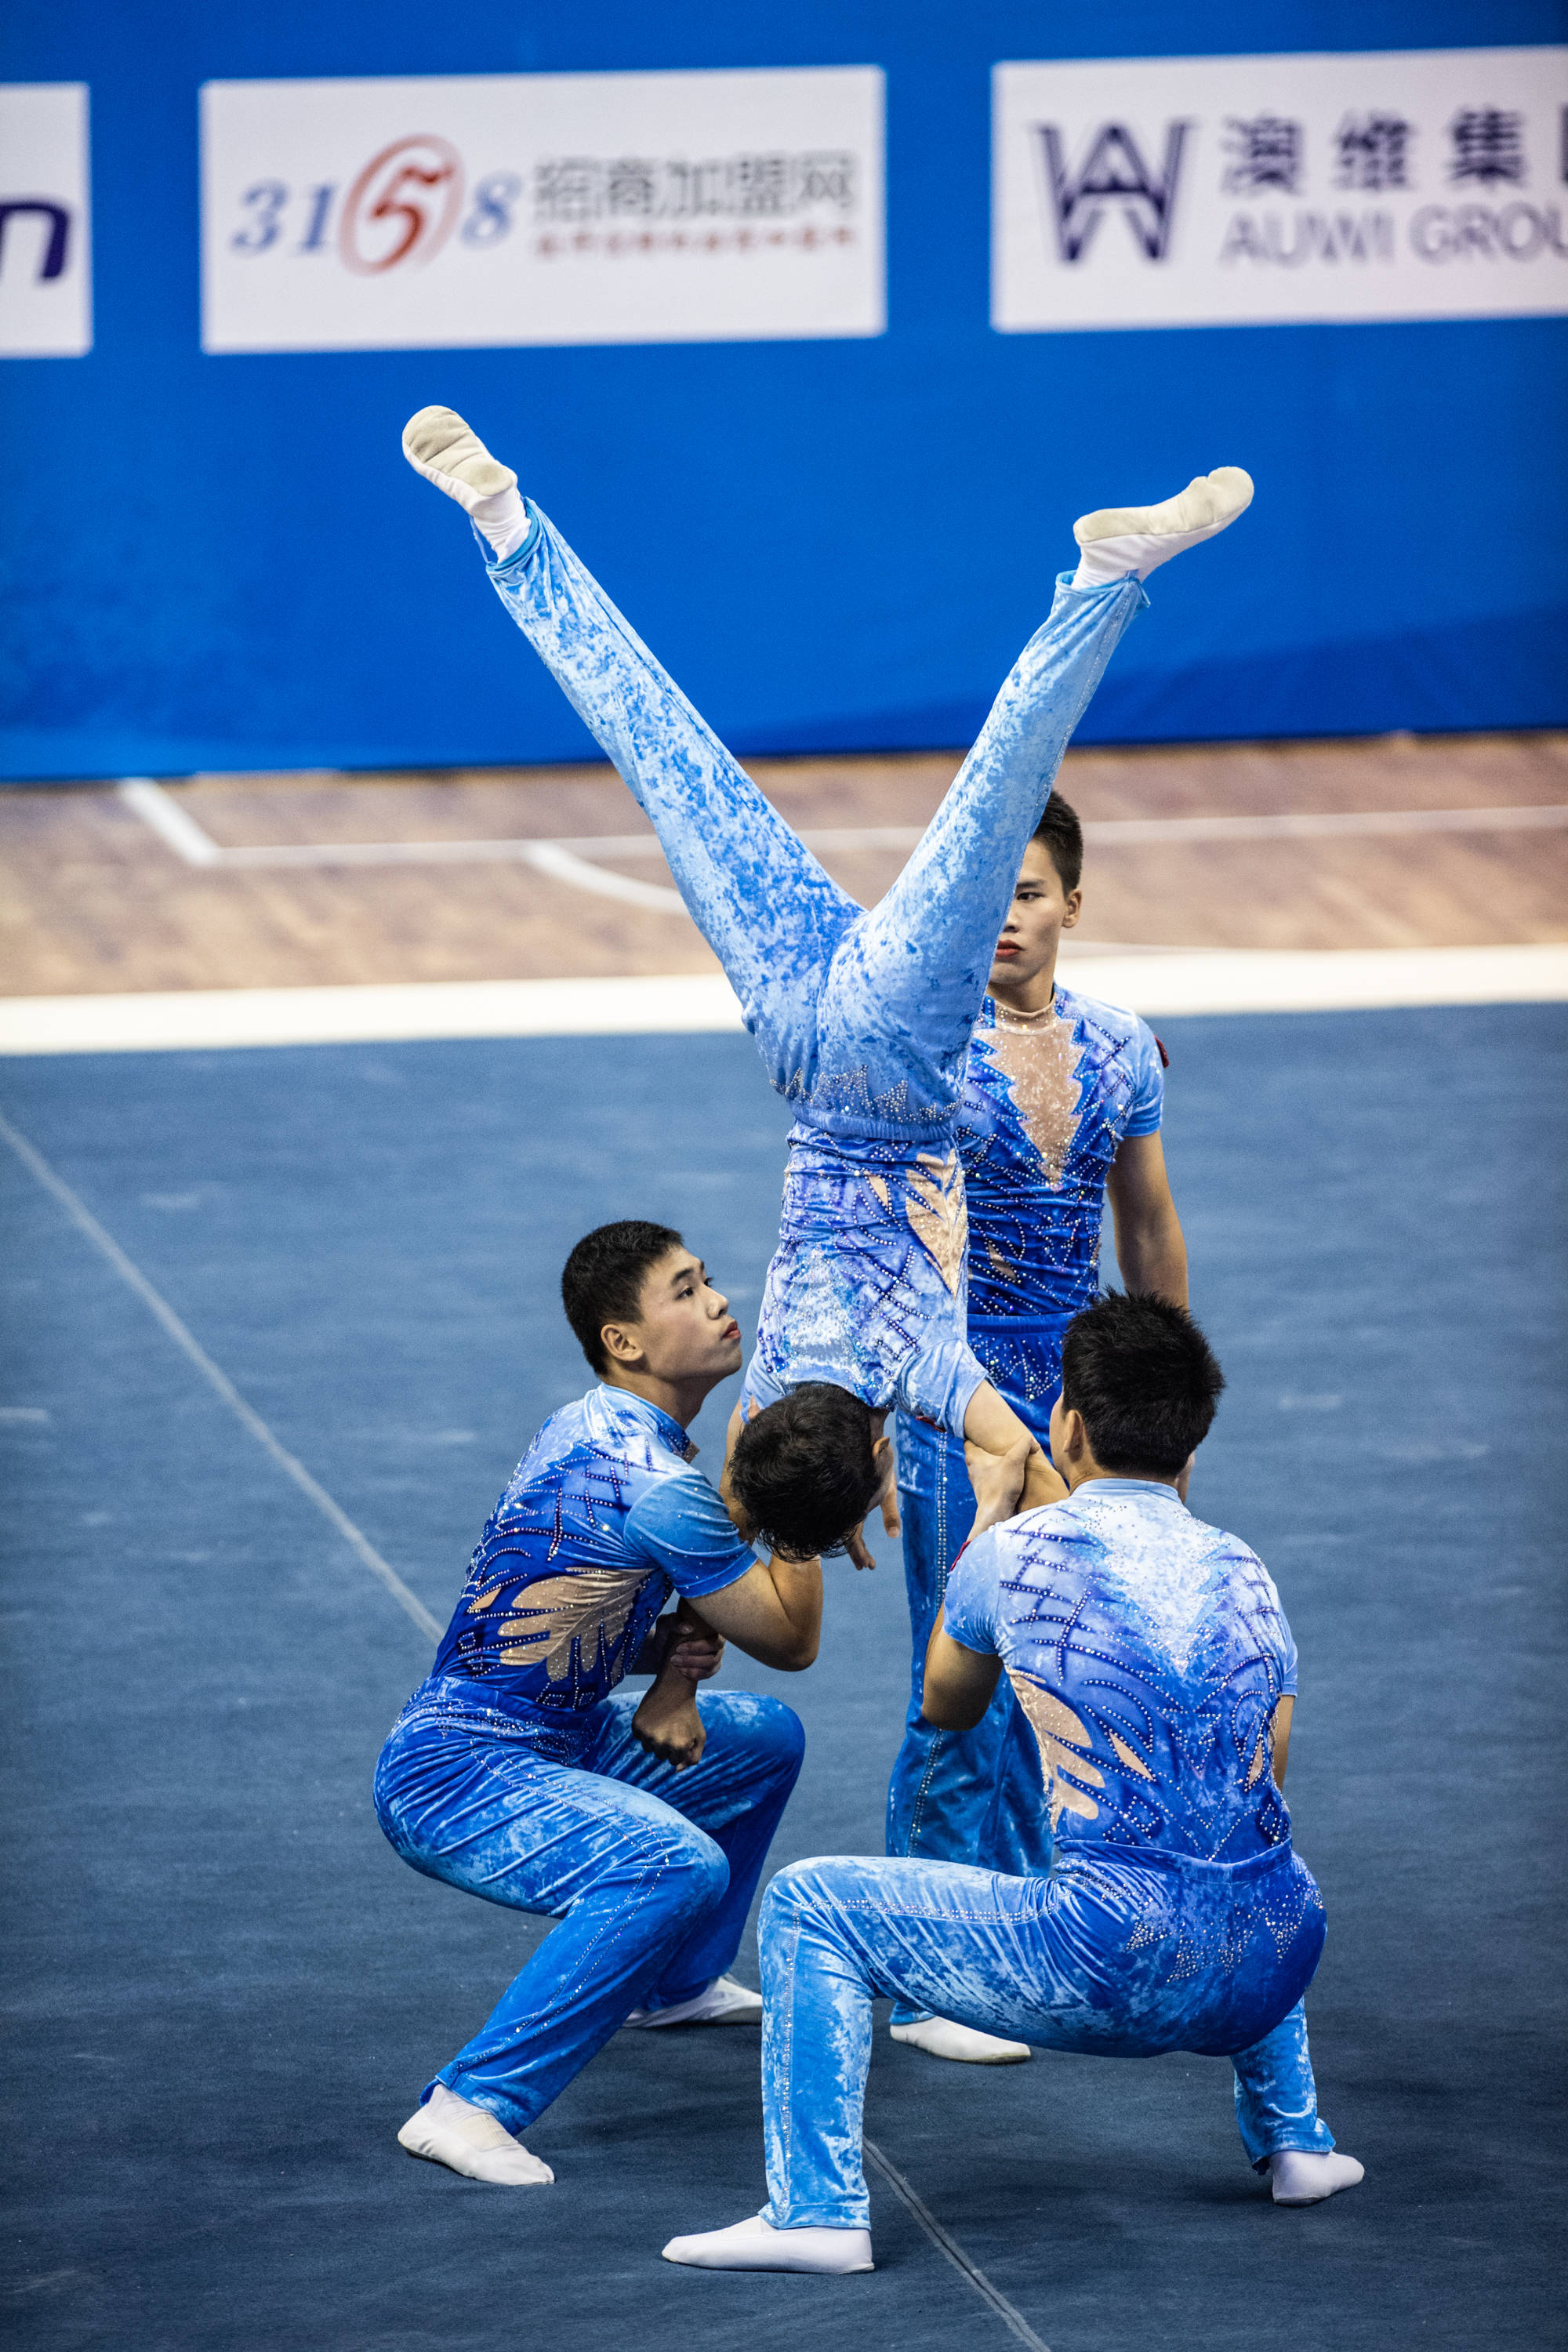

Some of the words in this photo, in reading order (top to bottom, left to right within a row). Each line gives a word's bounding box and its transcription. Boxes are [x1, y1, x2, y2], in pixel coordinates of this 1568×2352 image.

[1220, 105, 1568, 193] 澳维集
[232, 136, 522, 274] 3158
[1223, 210, 1395, 265] AUWI
